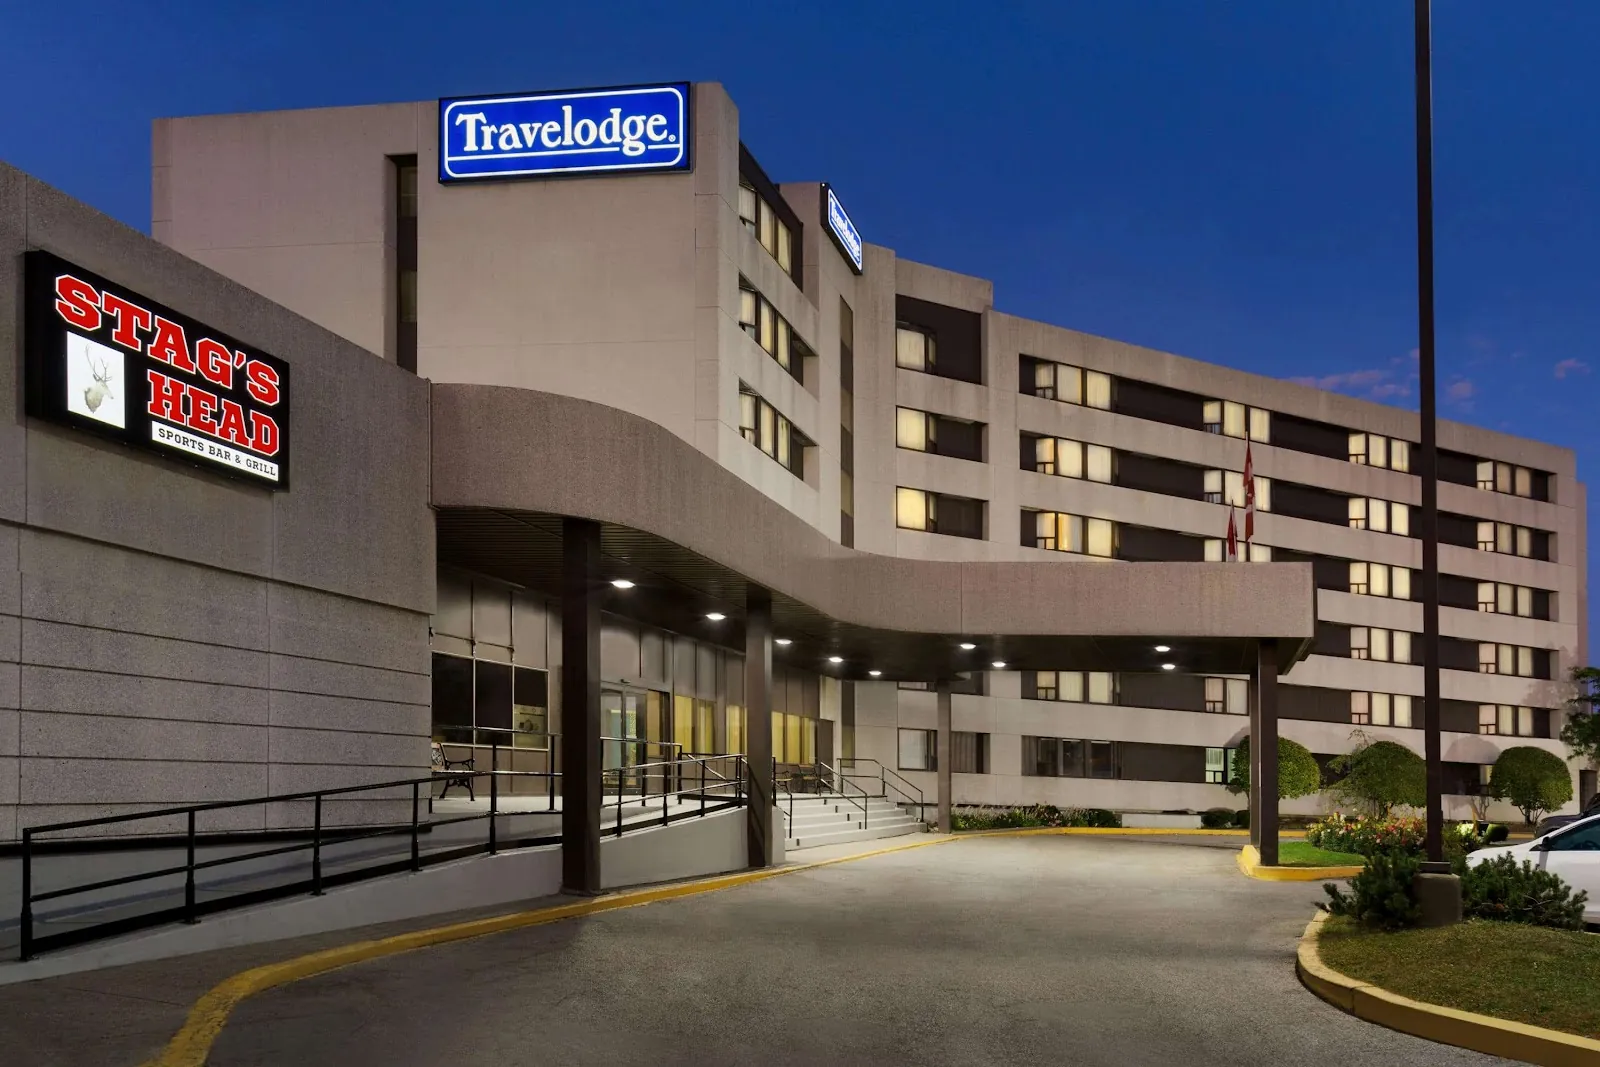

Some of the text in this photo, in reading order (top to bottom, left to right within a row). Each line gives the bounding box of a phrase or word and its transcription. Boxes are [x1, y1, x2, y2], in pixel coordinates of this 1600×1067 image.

[455, 105, 668, 157] Travelodge
[55, 274, 279, 405] STAG'S
[147, 369, 279, 456] HEAD
[158, 428, 276, 476] SPORTS BAR & GRILL
